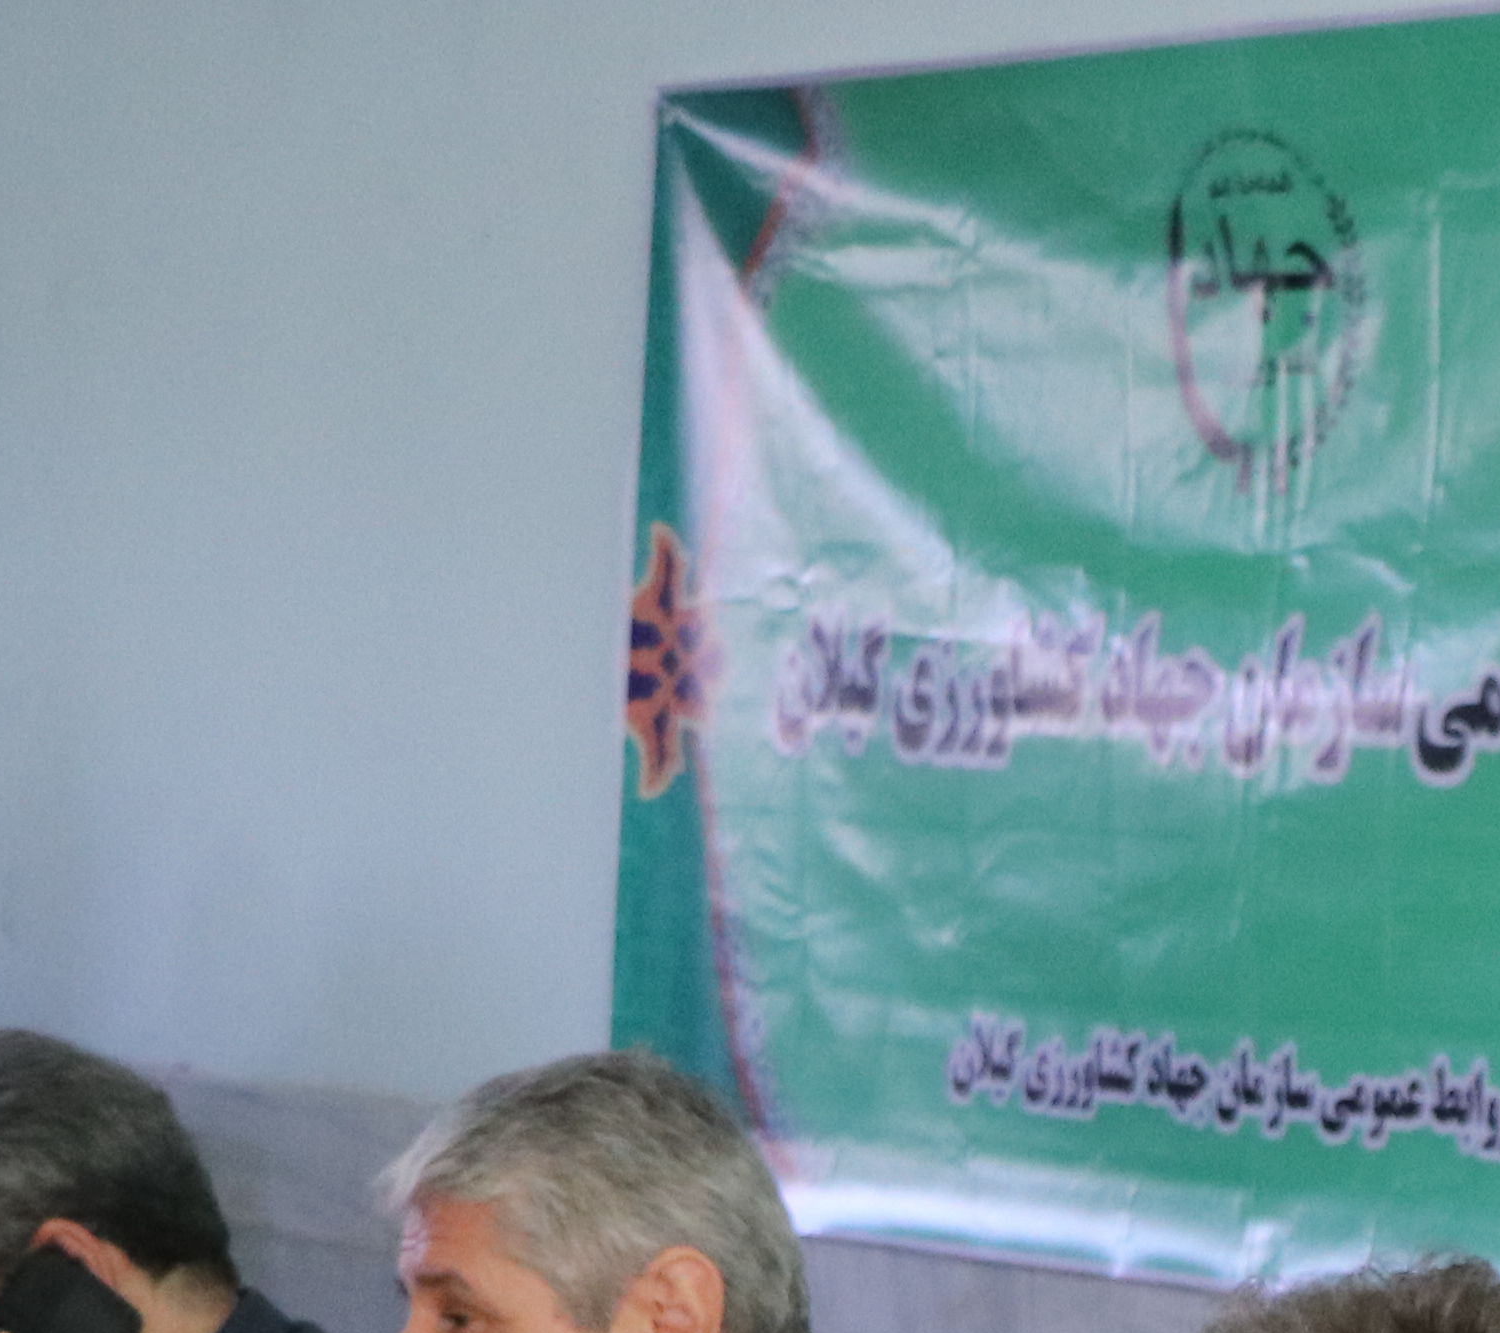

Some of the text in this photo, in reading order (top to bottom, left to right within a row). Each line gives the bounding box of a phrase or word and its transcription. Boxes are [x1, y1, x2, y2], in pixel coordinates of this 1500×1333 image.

[775, 613, 890, 758] گیلان
[895, 614, 1102, 766] کشاورزی
[1100, 612, 1216, 768] جهاد
[1222, 617, 1407, 773] سازمان
[950, 1017, 1021, 1103] گیلان
[1023, 1035, 1143, 1113] کشاورزی
[1146, 1039, 1207, 1122] جهاد
[1213, 1046, 1315, 1132] سازمان
[1320, 1076, 1424, 1143] عمومی
